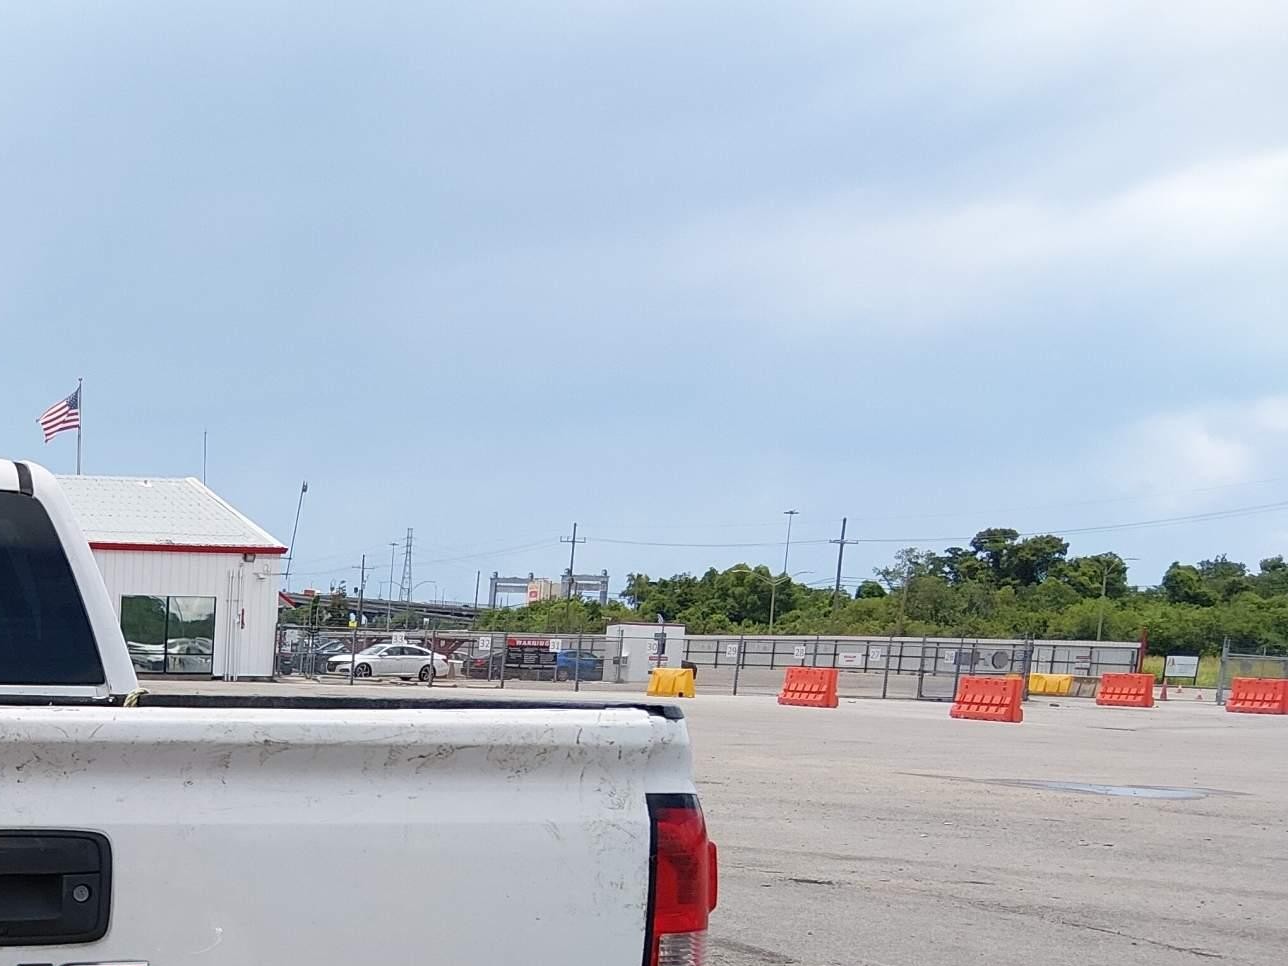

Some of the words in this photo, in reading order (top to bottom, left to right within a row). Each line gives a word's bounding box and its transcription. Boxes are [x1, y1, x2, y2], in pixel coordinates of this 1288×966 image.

[479, 639, 490, 648] 32
[727, 646, 737, 655] 29
[870, 650, 880, 659] 27
